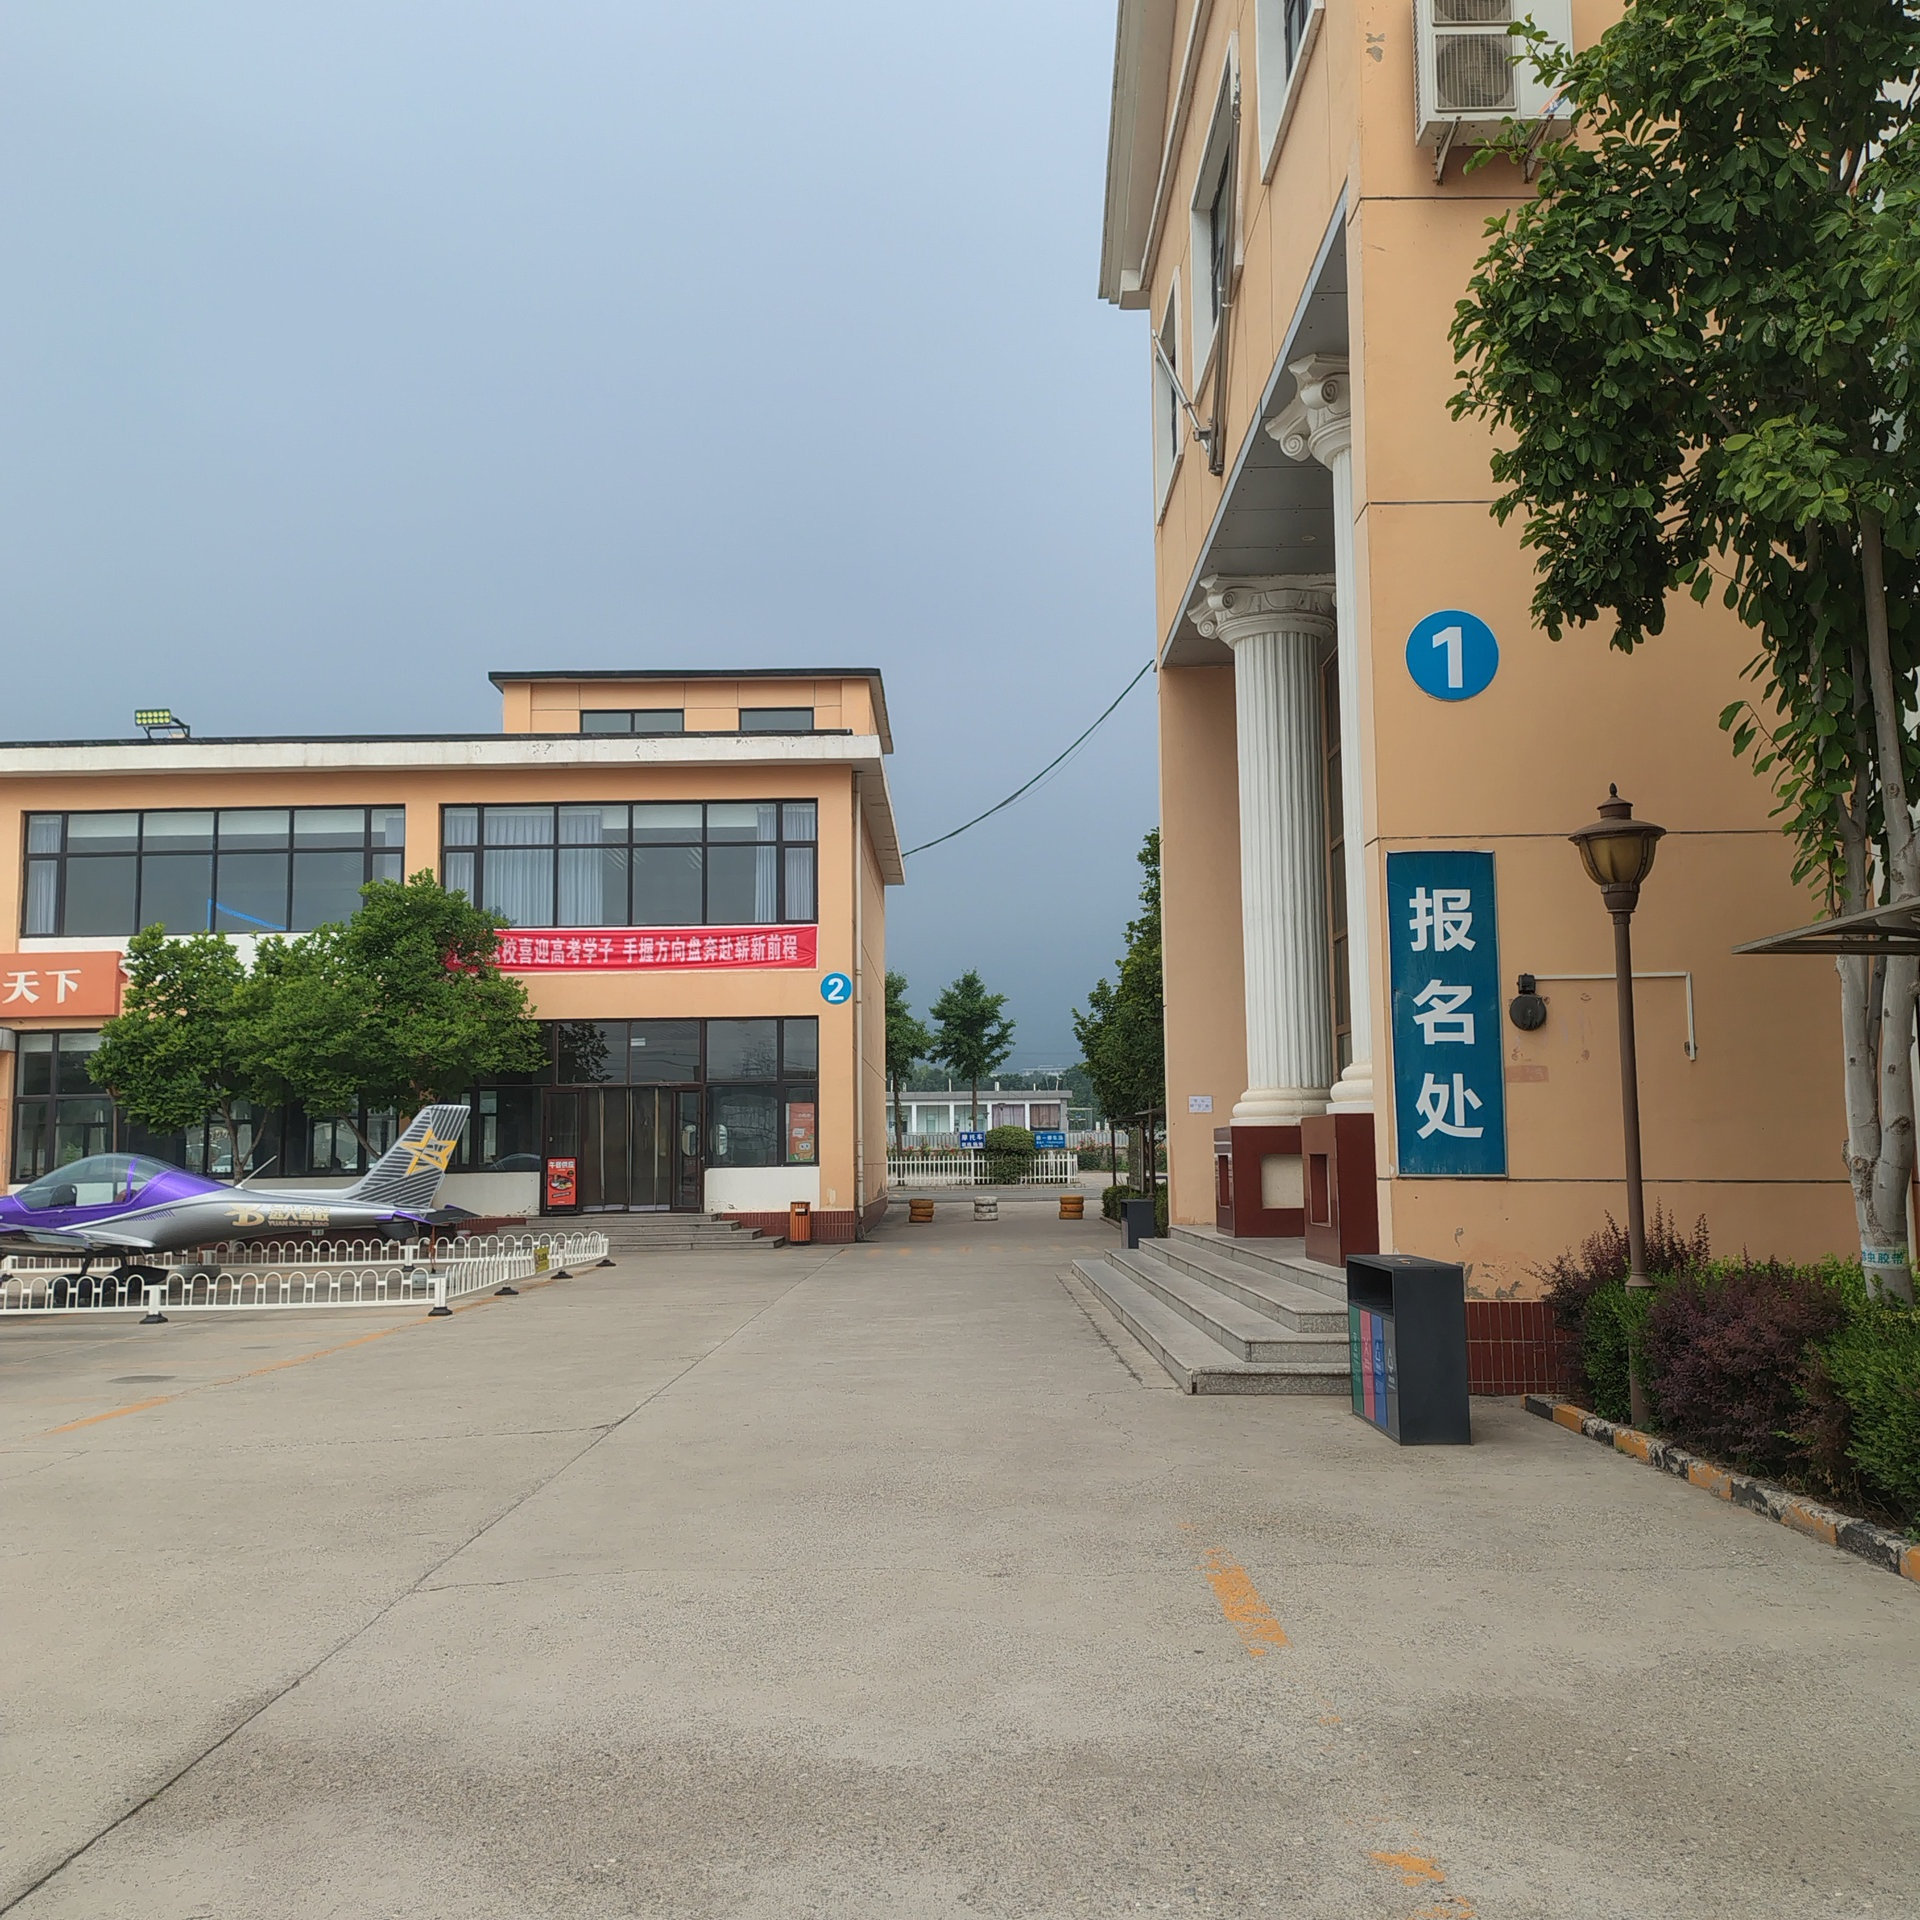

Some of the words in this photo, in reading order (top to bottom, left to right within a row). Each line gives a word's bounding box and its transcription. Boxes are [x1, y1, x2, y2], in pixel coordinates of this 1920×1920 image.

[1432, 626, 1464, 689] 1
[453, 937, 614, 965] 校喜迎高考学子
[622, 934, 798, 964] 手握方向盘奔赴崭新前程
[2, 969, 82, 1004] 天下
[828, 977, 845, 1001] 2
[1408, 886, 1484, 1140] 报名处
